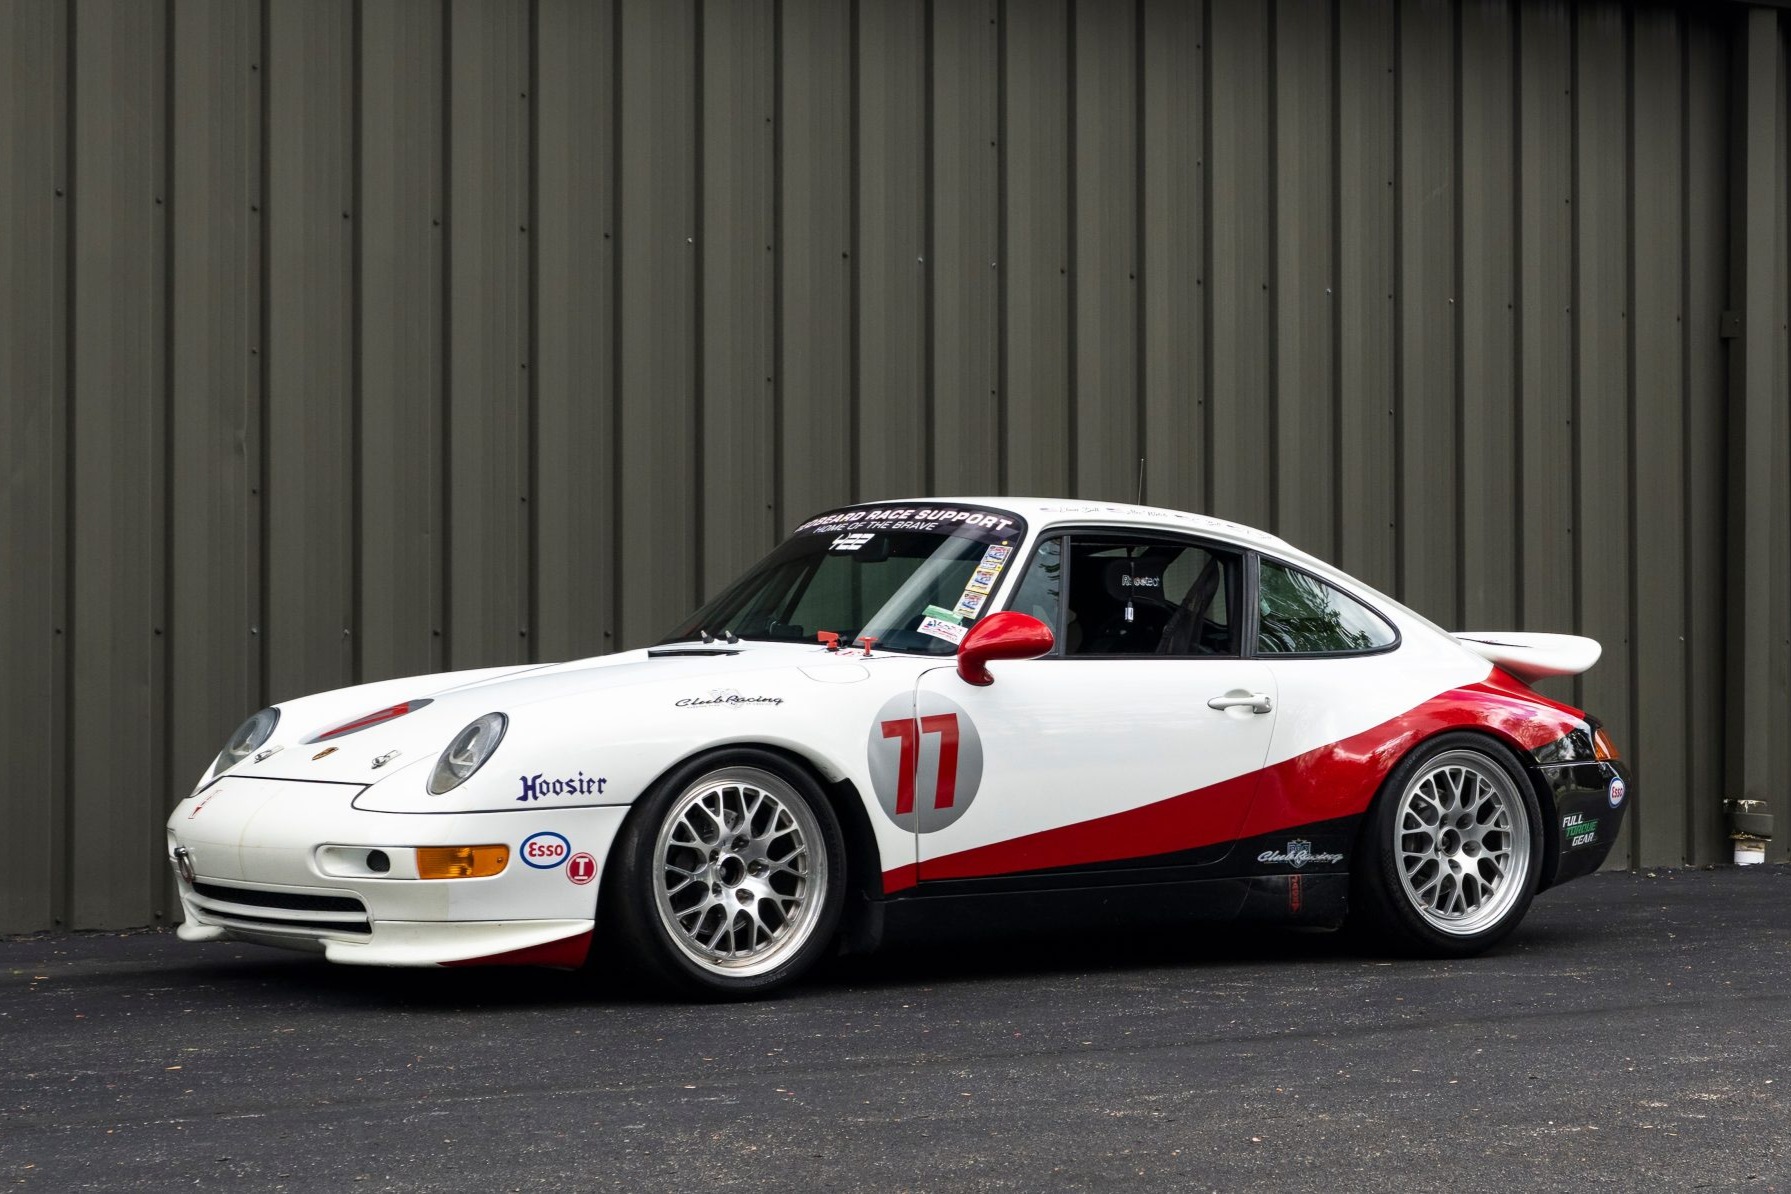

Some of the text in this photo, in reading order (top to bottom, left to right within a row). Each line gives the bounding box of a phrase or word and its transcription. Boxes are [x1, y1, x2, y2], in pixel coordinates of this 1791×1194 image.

[813, 521, 939, 534] HOME OF THE BRAVE
[865, 509, 915, 521] RACE
[915, 509, 1013, 531] SUPPORT
[881, 712, 960, 815] 77
[516, 771, 607, 801] Hoosier
[1562, 814, 1583, 828] FULL
[1572, 832, 1595, 847] GEAR
[528, 842, 564, 857] Esso
